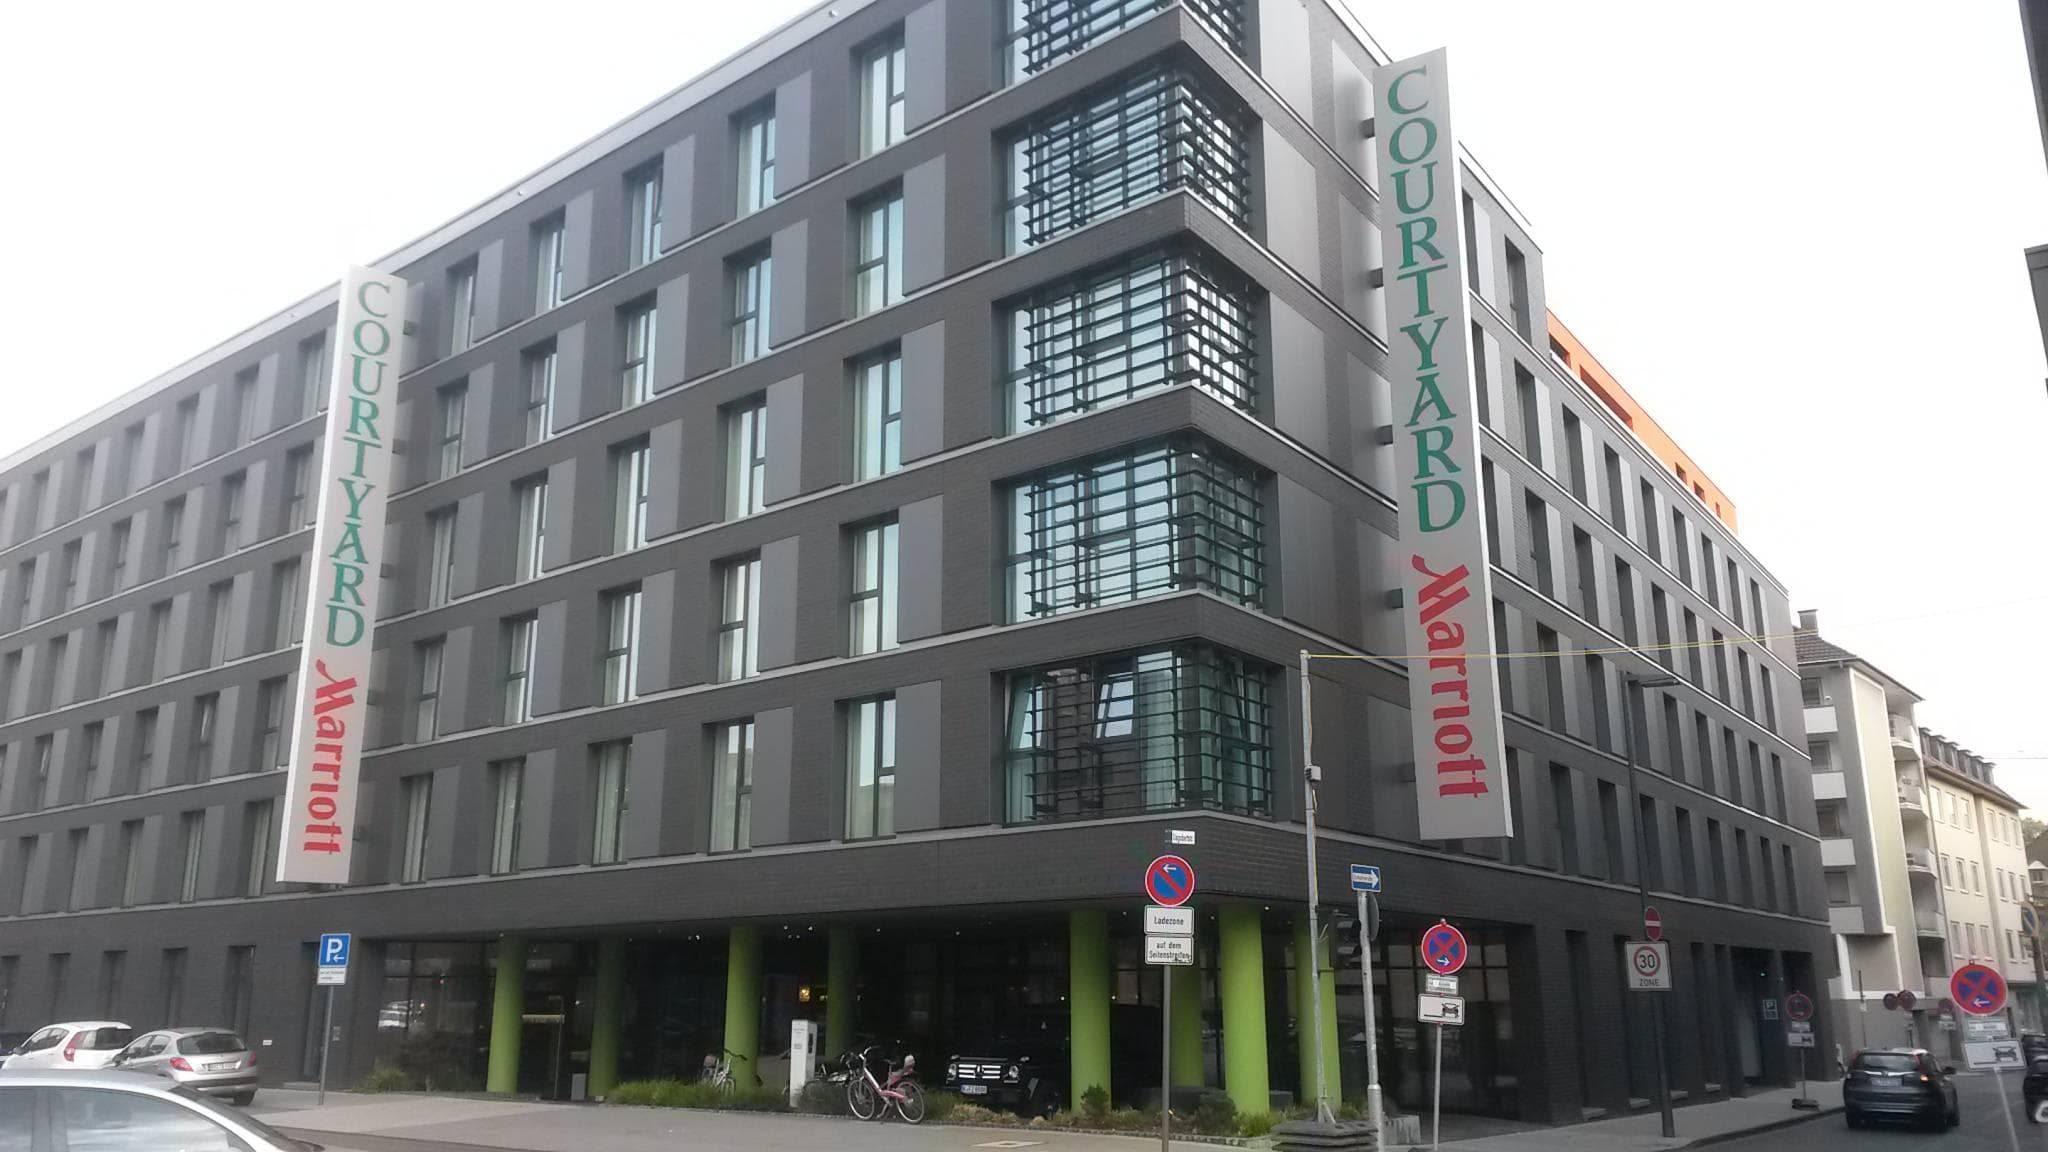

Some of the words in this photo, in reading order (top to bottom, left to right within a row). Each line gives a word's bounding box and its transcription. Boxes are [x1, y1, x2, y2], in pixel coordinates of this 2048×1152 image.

[1388, 67, 1466, 533] COURTYARD
[325, 281, 391, 648] COURTYARD
[1411, 554, 1488, 797] Marriott
[302, 658, 357, 856] Marriott
[1154, 916, 1184, 926] Ladezone
[326, 938, 343, 963] P
[1156, 941, 1166, 949] auf
[1168, 941, 1182, 949] dem
[1639, 954, 1655, 969] 30
[1639, 978, 1660, 987] ZONE
